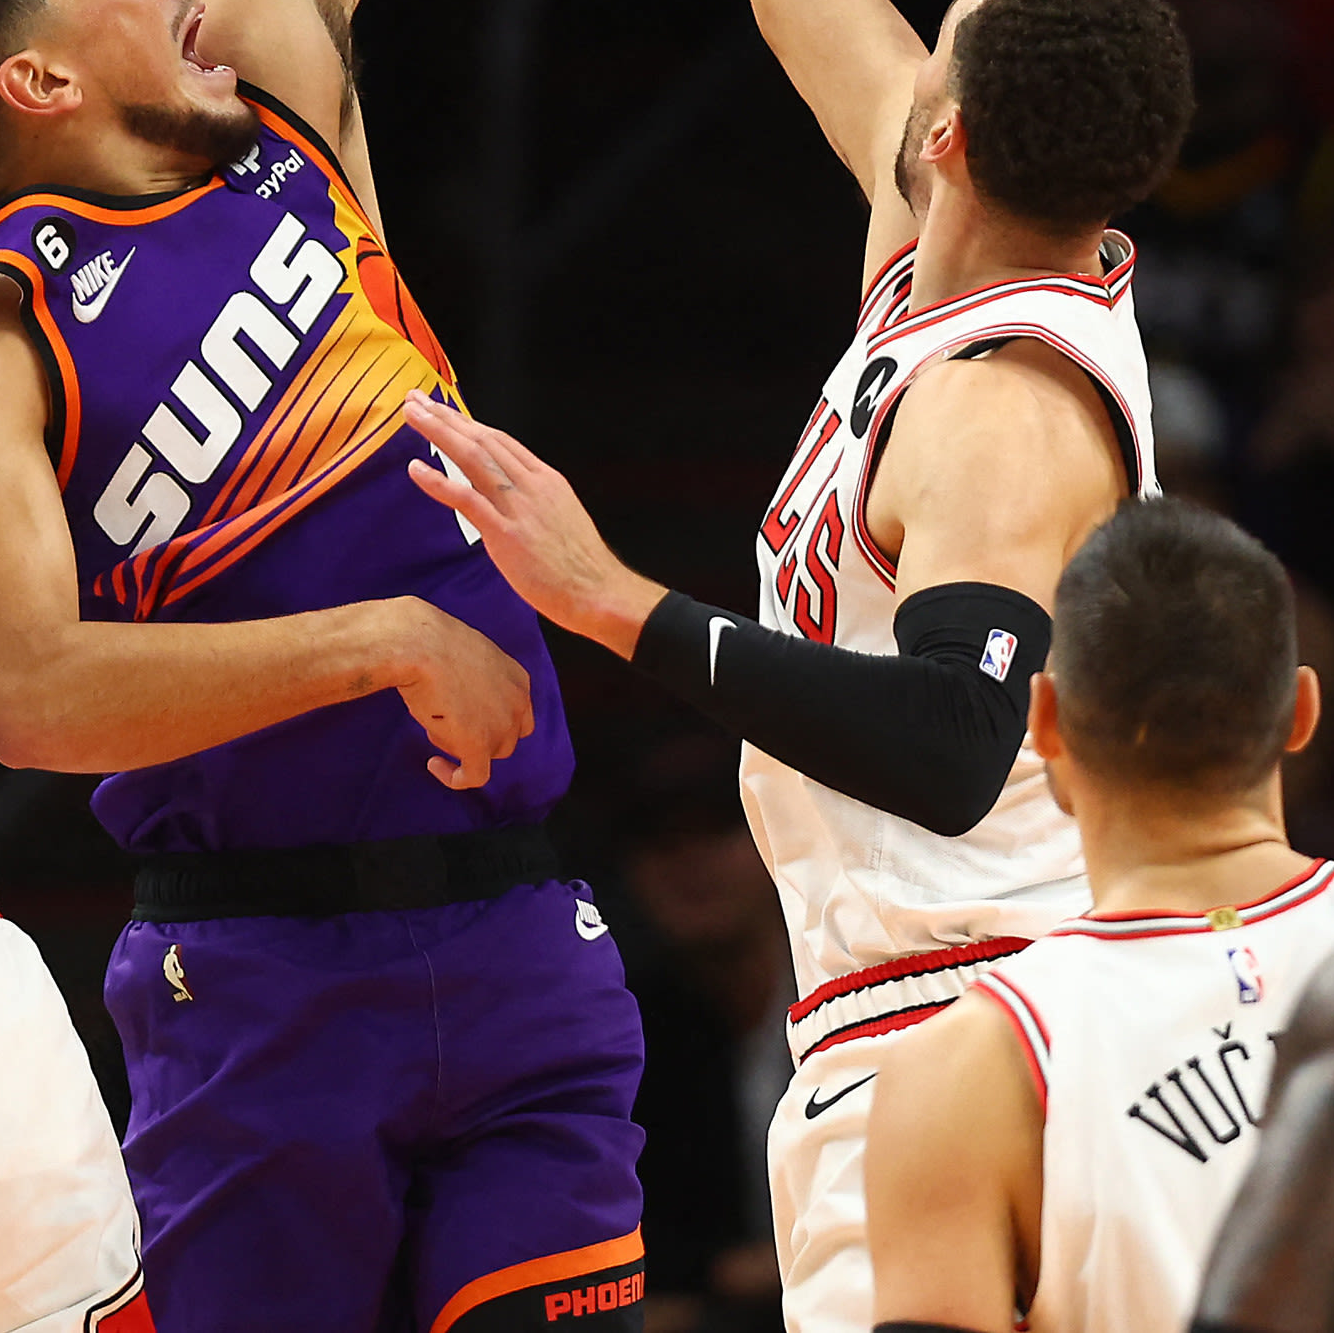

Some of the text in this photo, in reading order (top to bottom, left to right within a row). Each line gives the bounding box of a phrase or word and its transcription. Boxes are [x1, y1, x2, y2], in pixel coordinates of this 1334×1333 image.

[255, 148, 305, 199] ayPal
[36, 225, 69, 269] 6
[70, 251, 118, 302] NIKE
[1126, 1021, 1273, 1163] VUČ
[544, 1271, 645, 1322] PHOENI
